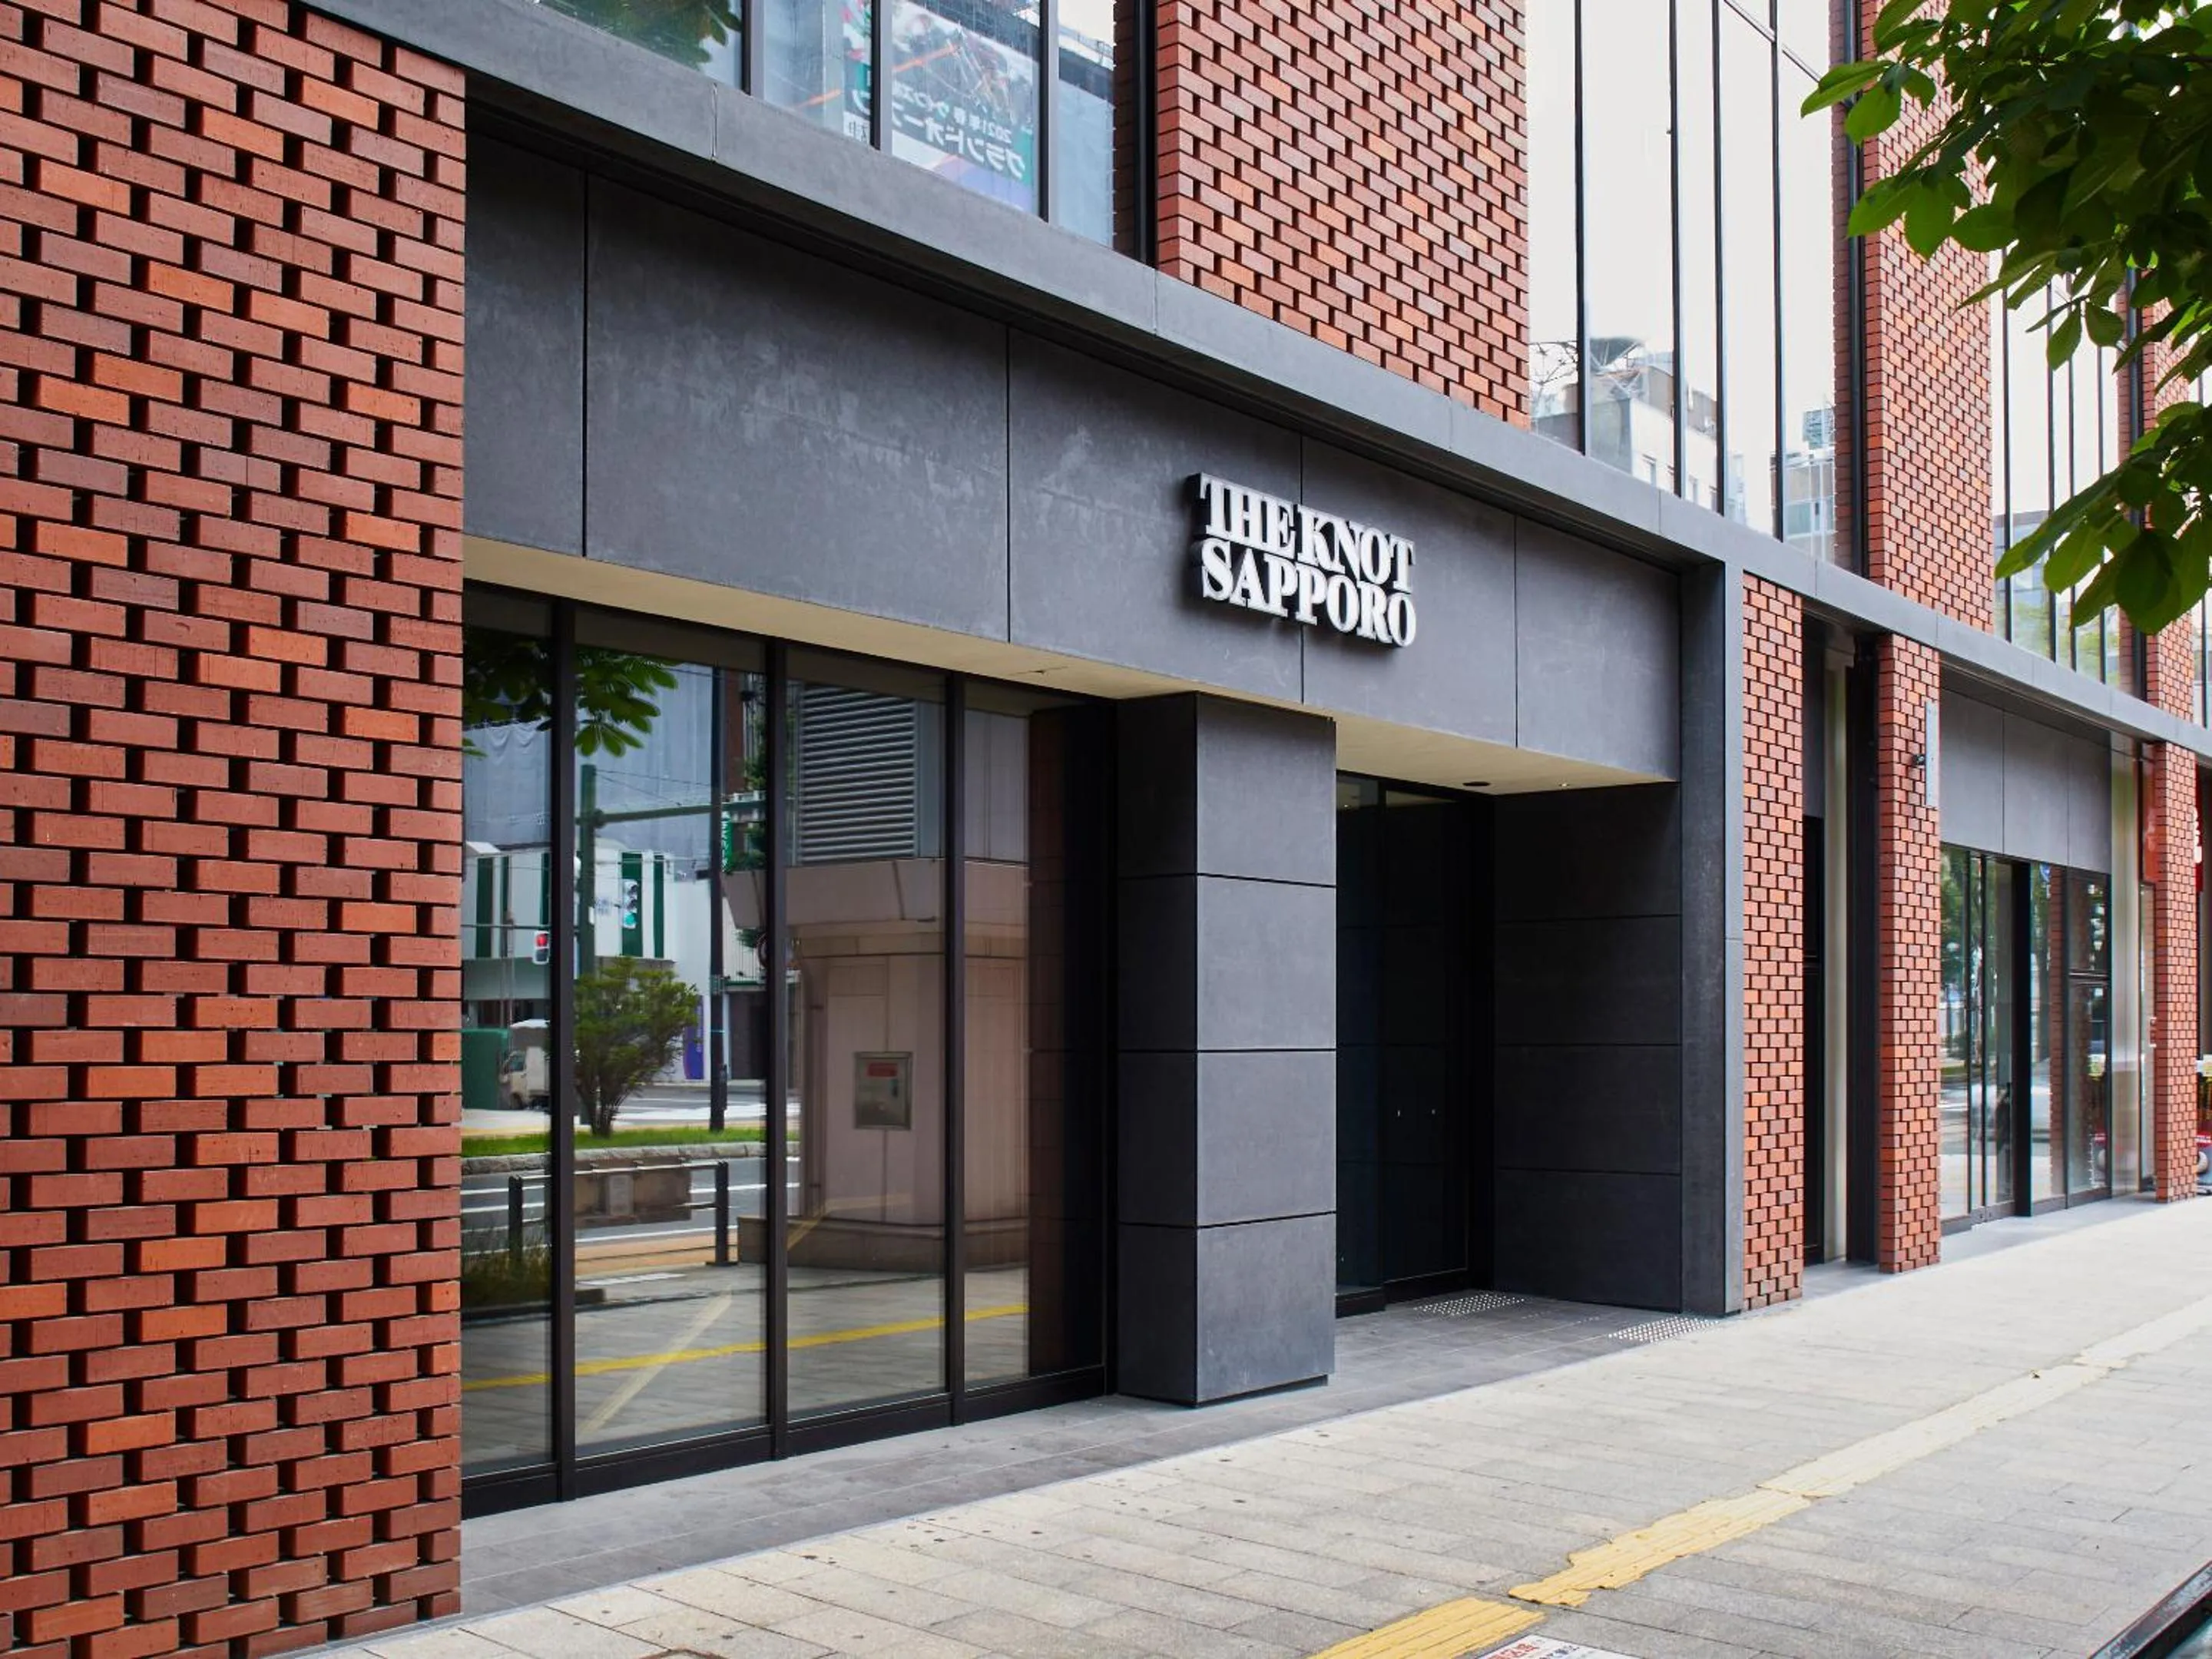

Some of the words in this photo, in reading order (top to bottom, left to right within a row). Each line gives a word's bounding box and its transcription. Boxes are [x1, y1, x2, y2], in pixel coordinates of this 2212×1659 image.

[1200, 472, 1296, 559] THE
[1296, 504, 1416, 592] KNOT
[1201, 538, 1416, 647] SAPPORO
